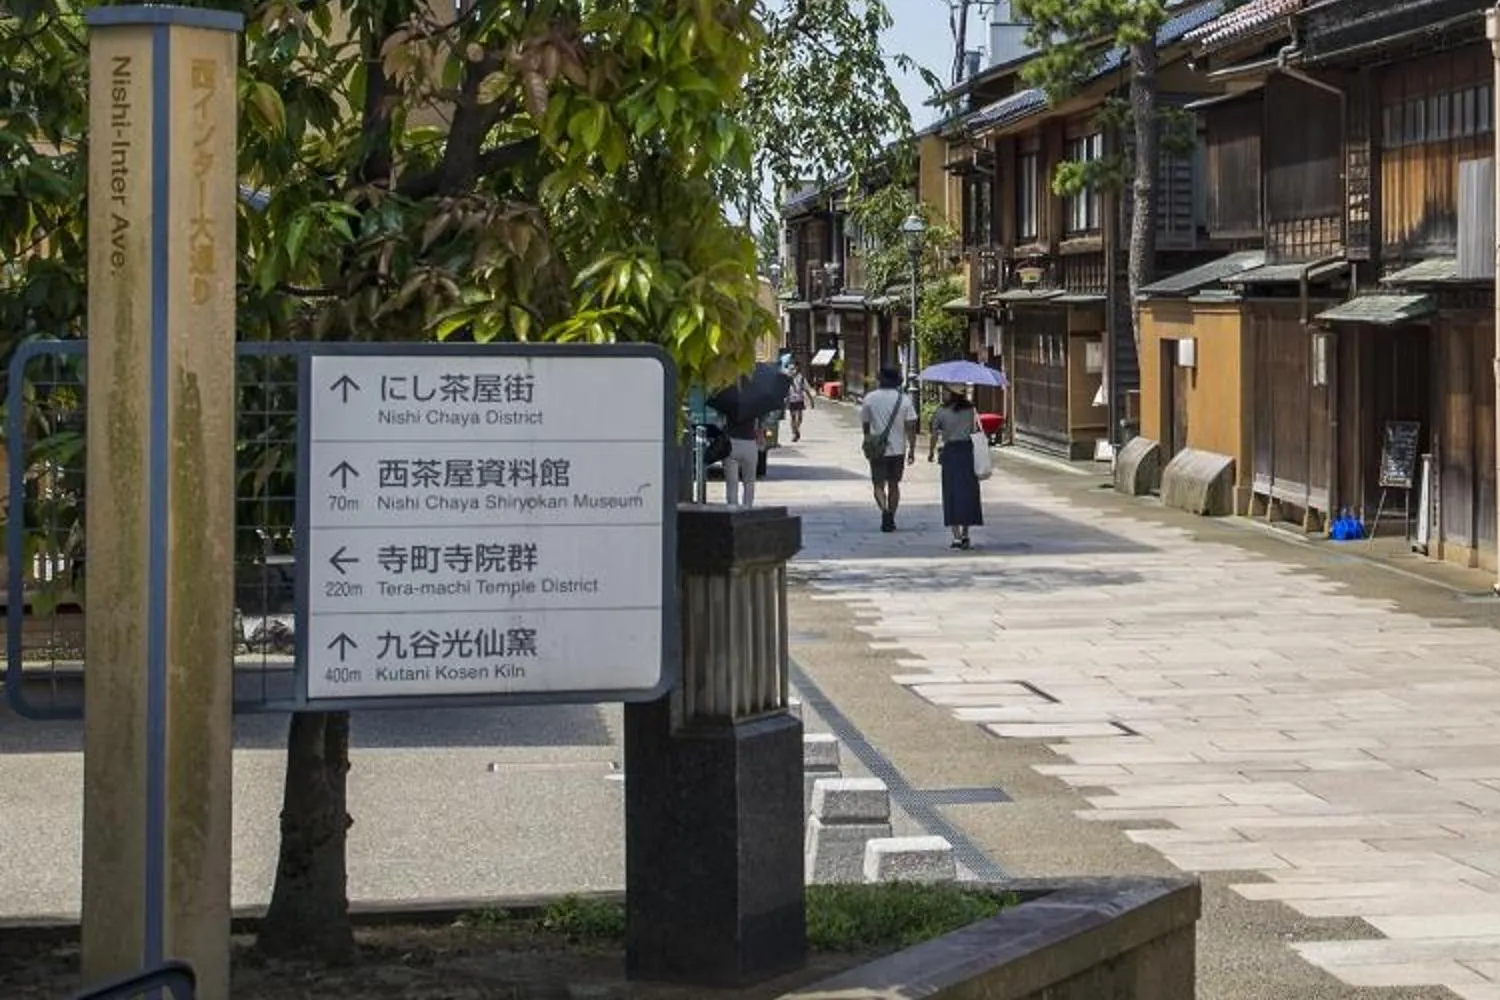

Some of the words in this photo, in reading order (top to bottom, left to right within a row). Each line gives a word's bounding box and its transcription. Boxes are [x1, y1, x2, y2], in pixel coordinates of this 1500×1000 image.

[111, 55, 132, 207] Nishi-Inter
[111, 212, 131, 277] Ave.
[380, 373, 535, 404] にし茶屋街
[378, 409, 420, 425] Nishi
[425, 410, 481, 427] Chaya
[485, 409, 543, 425] District
[377, 457, 571, 489] 西茶屋資料館
[328, 494, 359, 511] 70m
[377, 495, 420, 511] Nishi
[425, 494, 480, 514] Chaya
[485, 493, 568, 514] Shiryokan
[573, 492, 643, 509] Museum
[377, 543, 539, 574] 寺町寺院群
[325, 580, 363, 598] 220m
[377, 579, 471, 597] Tera-machi
[476, 579, 536, 597] Temple
[541, 577, 598, 594] District
[376, 627, 538, 660] 九谷光仙窯
[324, 667, 362, 684] 400m
[375, 666, 430, 682] Kutani
[435, 665, 489, 681] Kosen
[494, 663, 526, 679] Kiln
